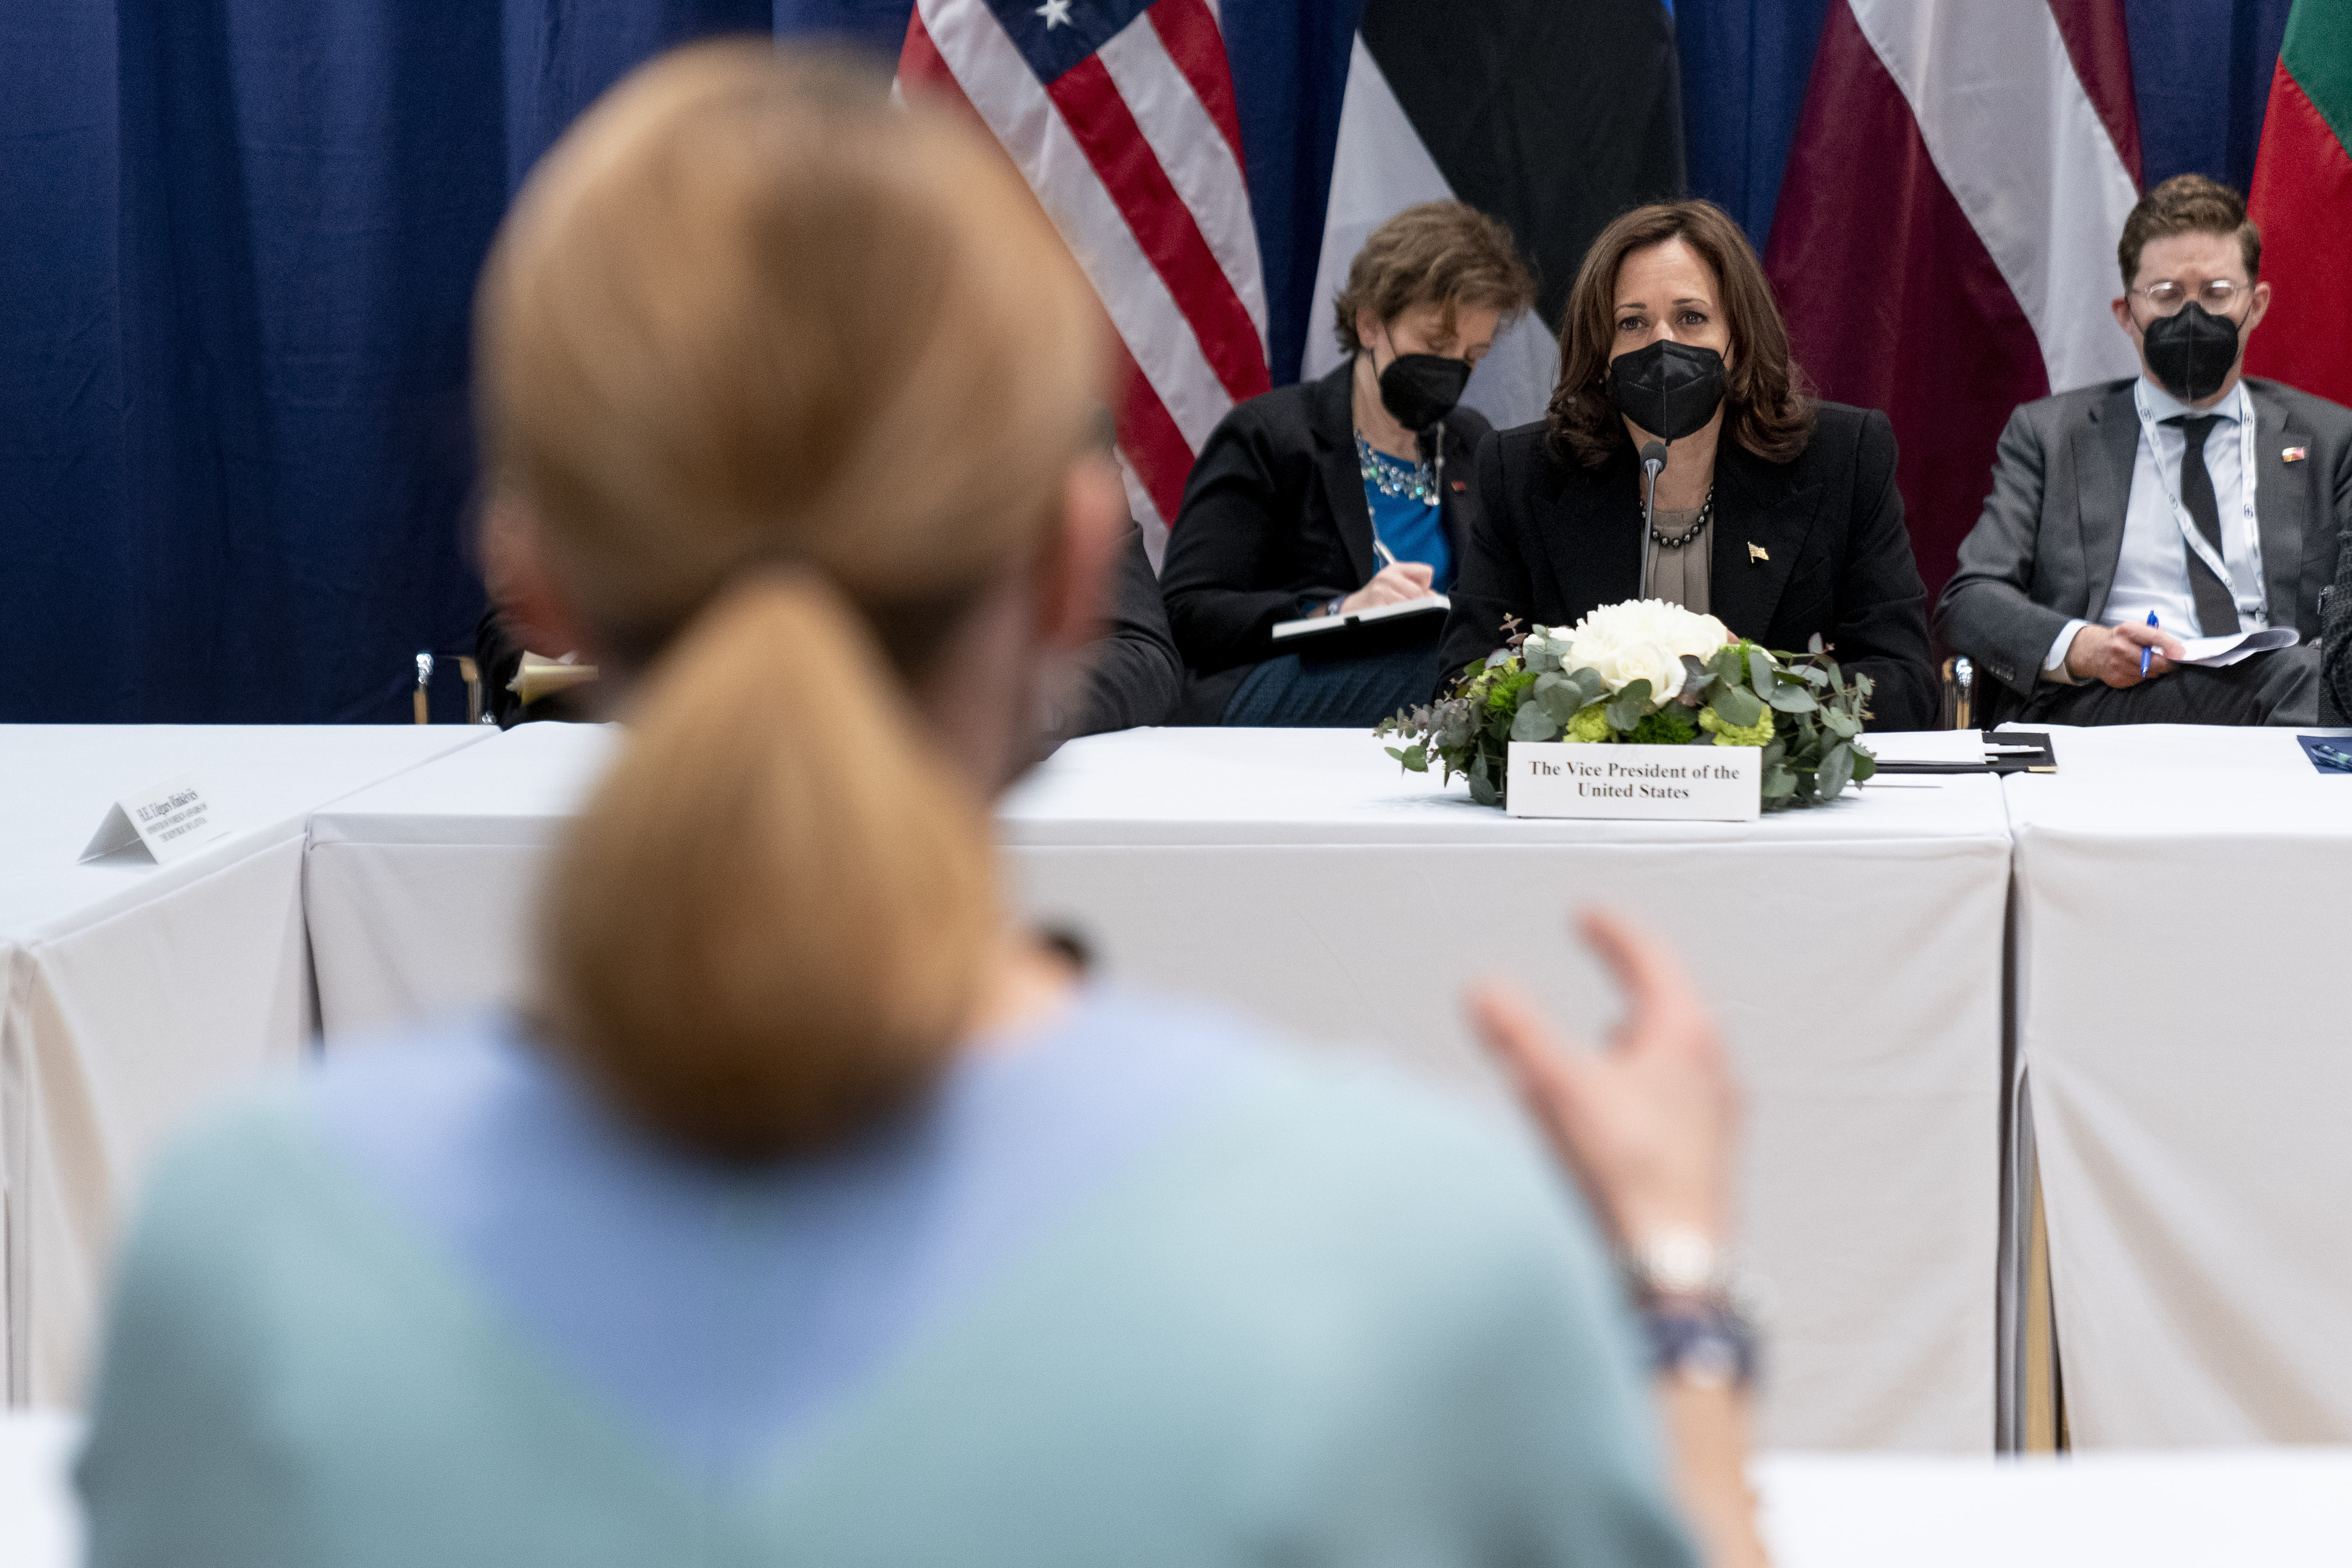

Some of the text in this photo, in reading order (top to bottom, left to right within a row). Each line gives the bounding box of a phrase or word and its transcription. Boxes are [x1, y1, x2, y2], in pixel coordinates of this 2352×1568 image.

[1529, 762, 1738, 779] The Vice President of the
[1579, 783, 1689, 798] United States
